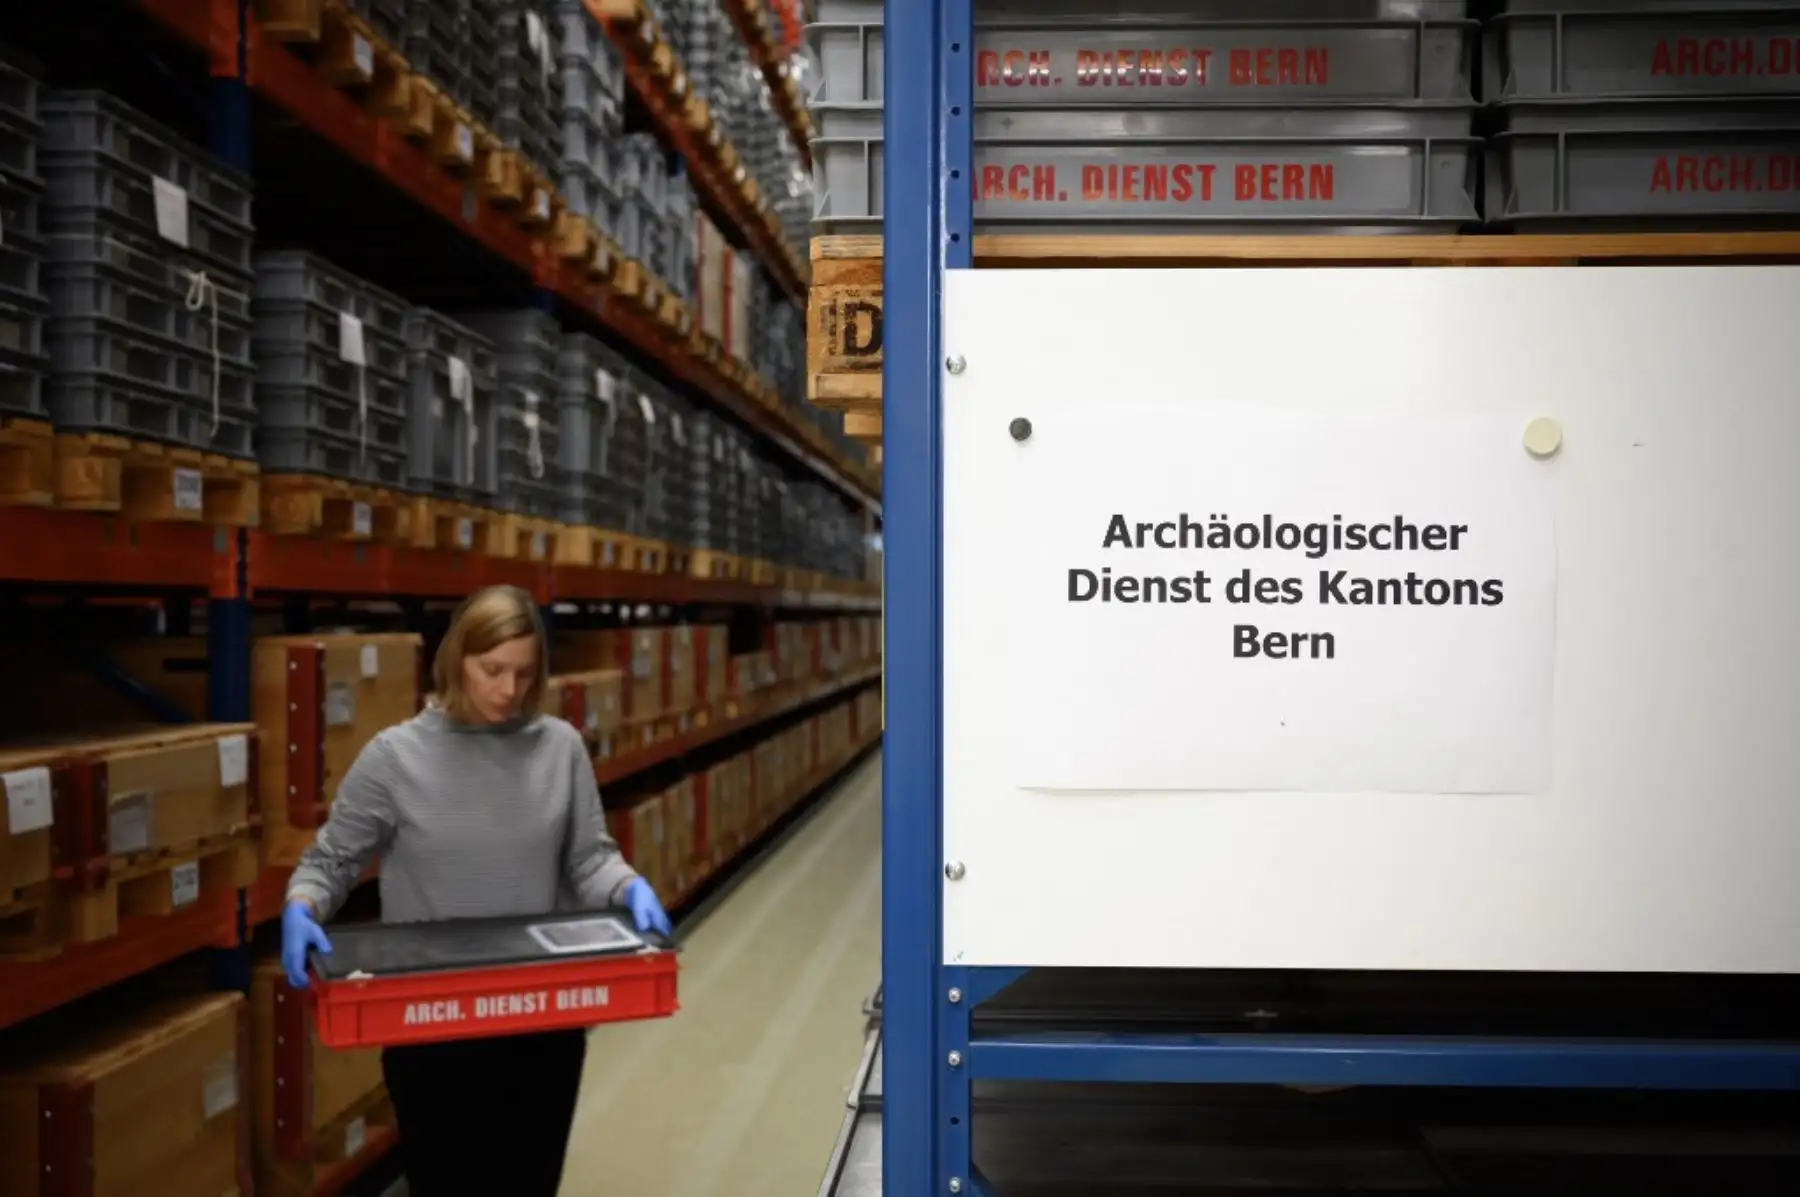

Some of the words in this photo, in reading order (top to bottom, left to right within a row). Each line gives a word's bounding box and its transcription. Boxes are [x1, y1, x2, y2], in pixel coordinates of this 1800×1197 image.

[976, 49, 1062, 87] RCH.
[1076, 47, 1213, 87] DIENST
[1228, 47, 1329, 87] BERN
[1081, 163, 1216, 203] DIENST
[1233, 162, 1335, 202] BERN
[1102, 513, 1468, 559] Archäologischer
[1068, 567, 1211, 604] Dienst
[1225, 569, 1303, 605] des
[1319, 570, 1504, 606] Kantons
[1233, 624, 1335, 659] Bern
[404, 1001, 466, 1025] ARCH.
[475, 991, 547, 1019] DIENST
[556, 986, 609, 1011] BERN
